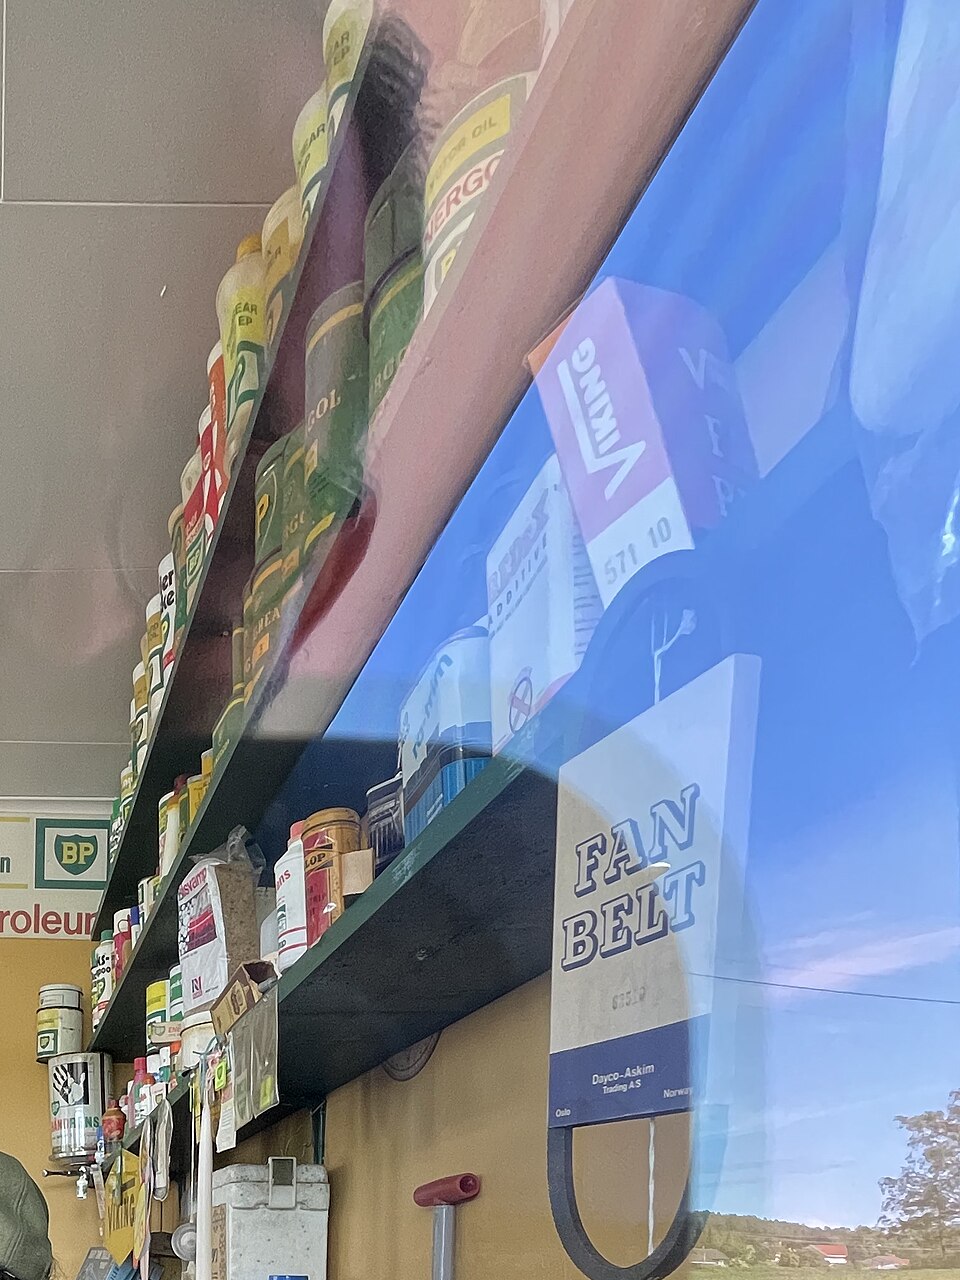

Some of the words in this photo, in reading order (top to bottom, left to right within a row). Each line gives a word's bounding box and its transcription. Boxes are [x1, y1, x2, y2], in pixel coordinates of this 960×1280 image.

[471, 116, 497, 140] OIL
[234, 301, 259, 316] EAR
[555, 336, 647, 501] VIKING
[646, 515, 672, 550] 10
[573, 782, 701, 898] FAN
[60, 841, 95, 866] BP
[560, 859, 706, 973] BELT
[591, 1063, 656, 1086] Dayco-Askim
[602, 1082, 628, 1095] Trading
[555, 1107, 571, 1118] Oslo
